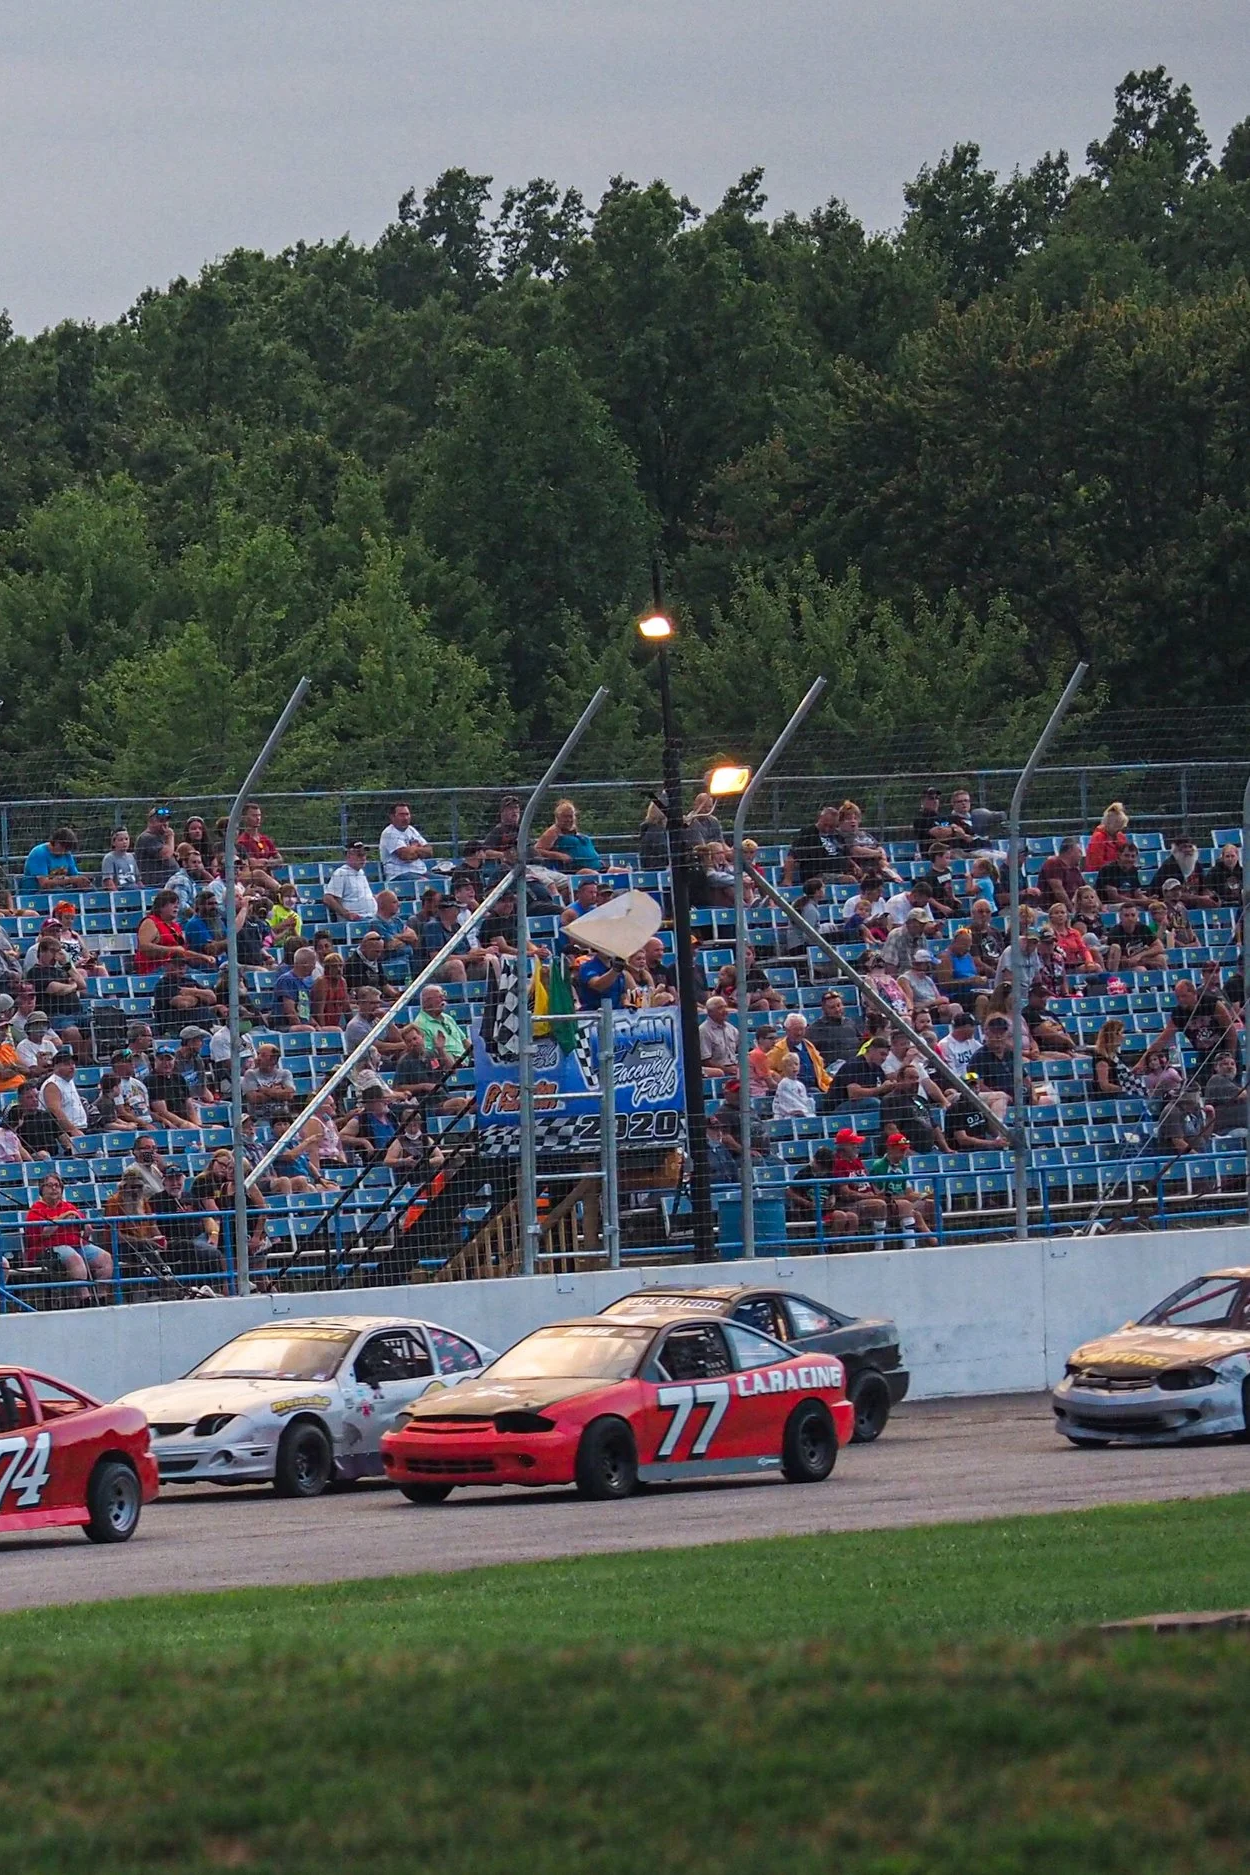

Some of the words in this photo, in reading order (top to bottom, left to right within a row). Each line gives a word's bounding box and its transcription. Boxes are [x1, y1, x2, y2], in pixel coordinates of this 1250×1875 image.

[634, 1074, 675, 1103] Park
[579, 1110, 678, 1141] 2020
[657, 1381, 730, 1460] 77
